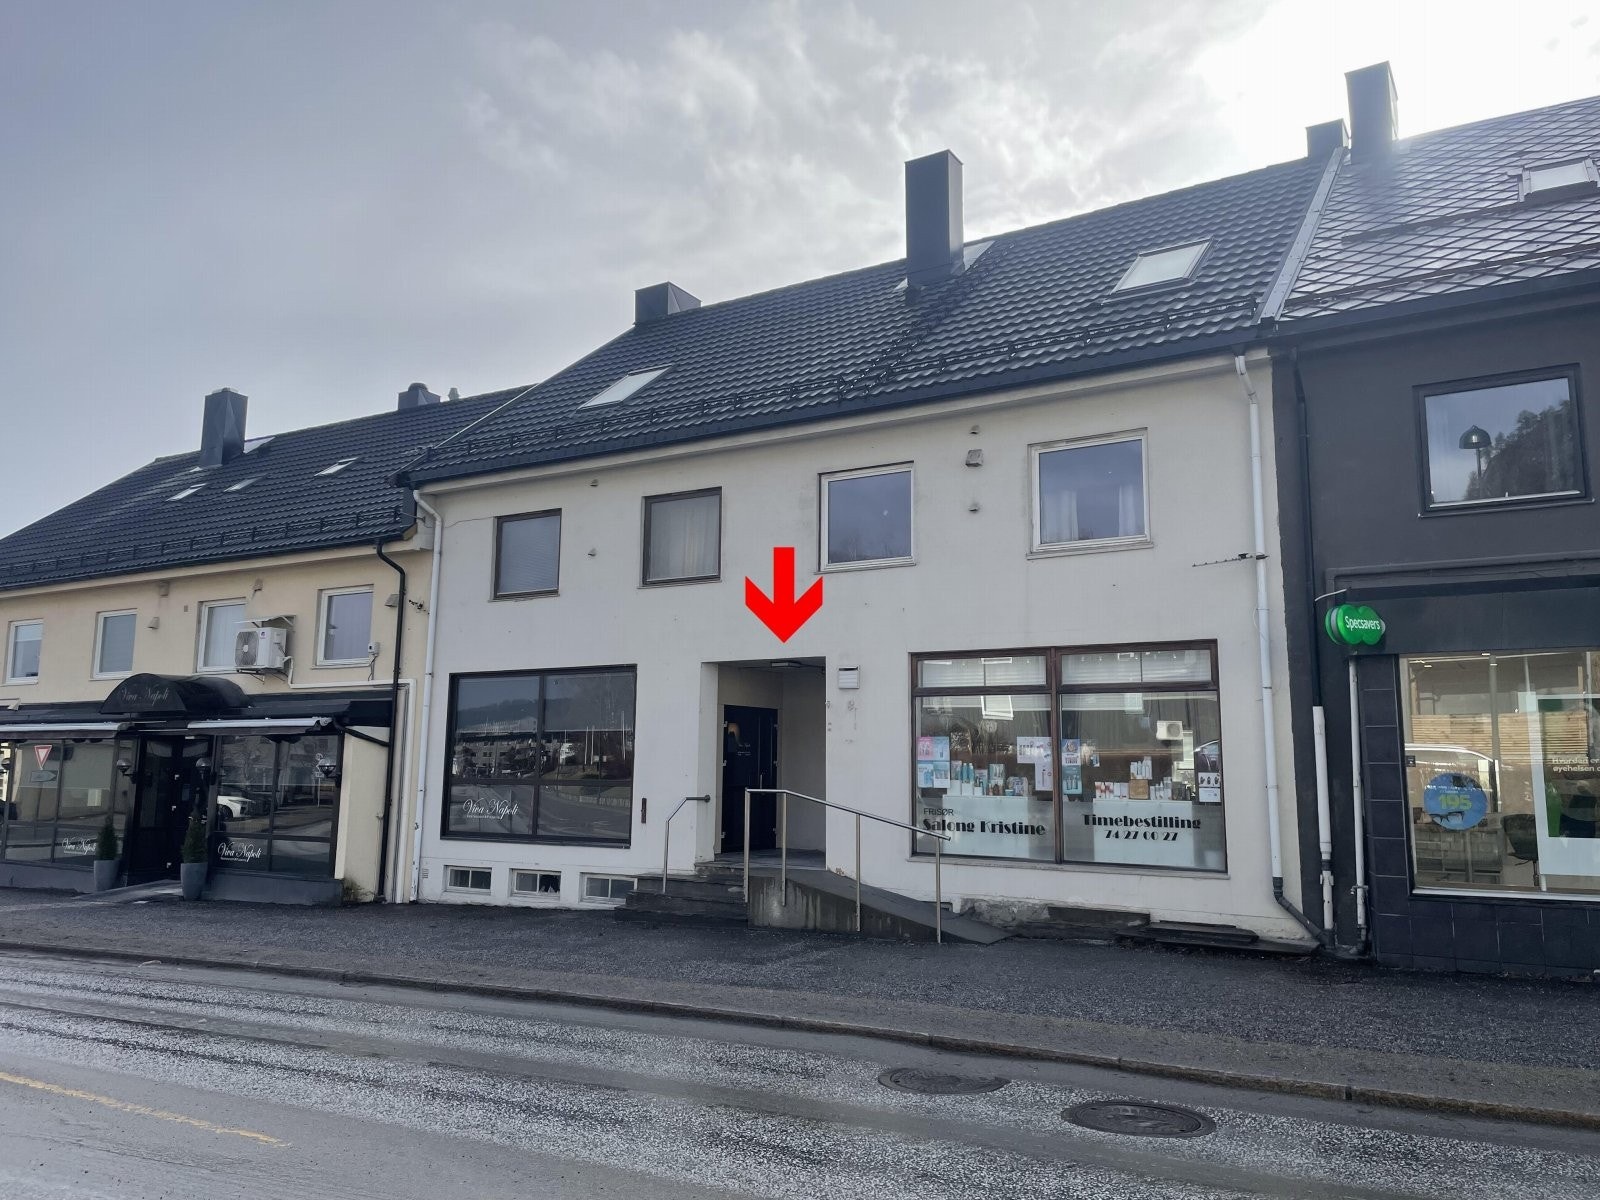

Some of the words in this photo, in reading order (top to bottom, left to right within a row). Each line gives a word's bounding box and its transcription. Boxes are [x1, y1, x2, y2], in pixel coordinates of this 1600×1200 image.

[1344, 615, 1381, 632] Specsavers
[121, 687, 140, 701] Viva
[140, 684, 169, 706] Napoli
[1552, 765, 1595, 773] øyehelsen
[462, 798, 485, 814] Viva
[487, 799, 519, 820] Napoli
[1439, 793, 1472, 810] 195
[923, 808, 955, 816] FRISØR
[922, 818, 975, 833] Salong
[980, 820, 1046, 836] Kristine
[1082, 814, 1202, 830] Timebestilling
[1105, 829, 1120, 839] 74
[1124, 830, 1139, 840] 27
[1143, 831, 1159, 841] 00
[1163, 832, 1179, 841] 27
[217, 841, 236, 856] Viva
[236, 842, 262, 863] Napoli
